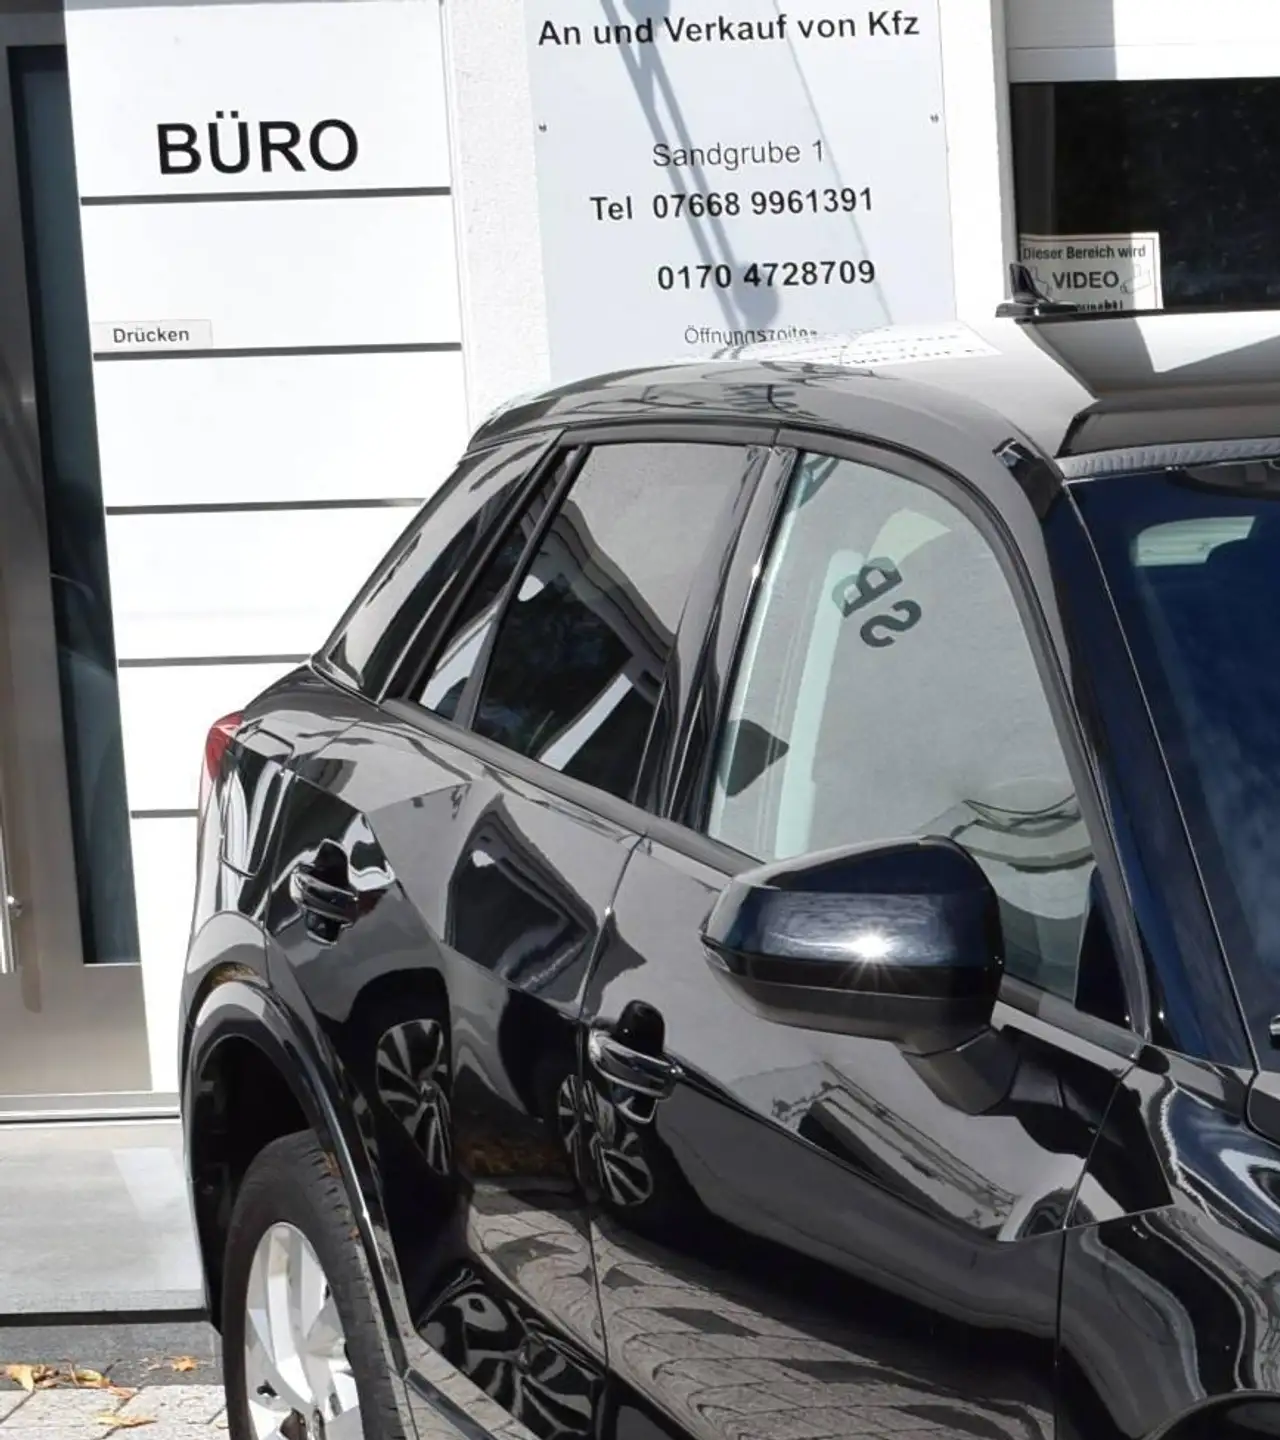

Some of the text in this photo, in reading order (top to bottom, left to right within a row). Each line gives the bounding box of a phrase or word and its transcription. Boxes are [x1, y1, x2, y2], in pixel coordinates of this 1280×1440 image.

[538, 10, 920, 45] An und Verkauf von Kfz
[157, 110, 359, 175] BÜRO
[652, 140, 824, 171] Sandgrube 1
[590, 187, 873, 221] Tel 07668 9961391
[1022, 243, 1146, 260] Dieser Bereich wird
[657, 260, 875, 290] 0170 4728709
[1052, 270, 1119, 289] VIDEO
[113, 326, 190, 345] Drücken
